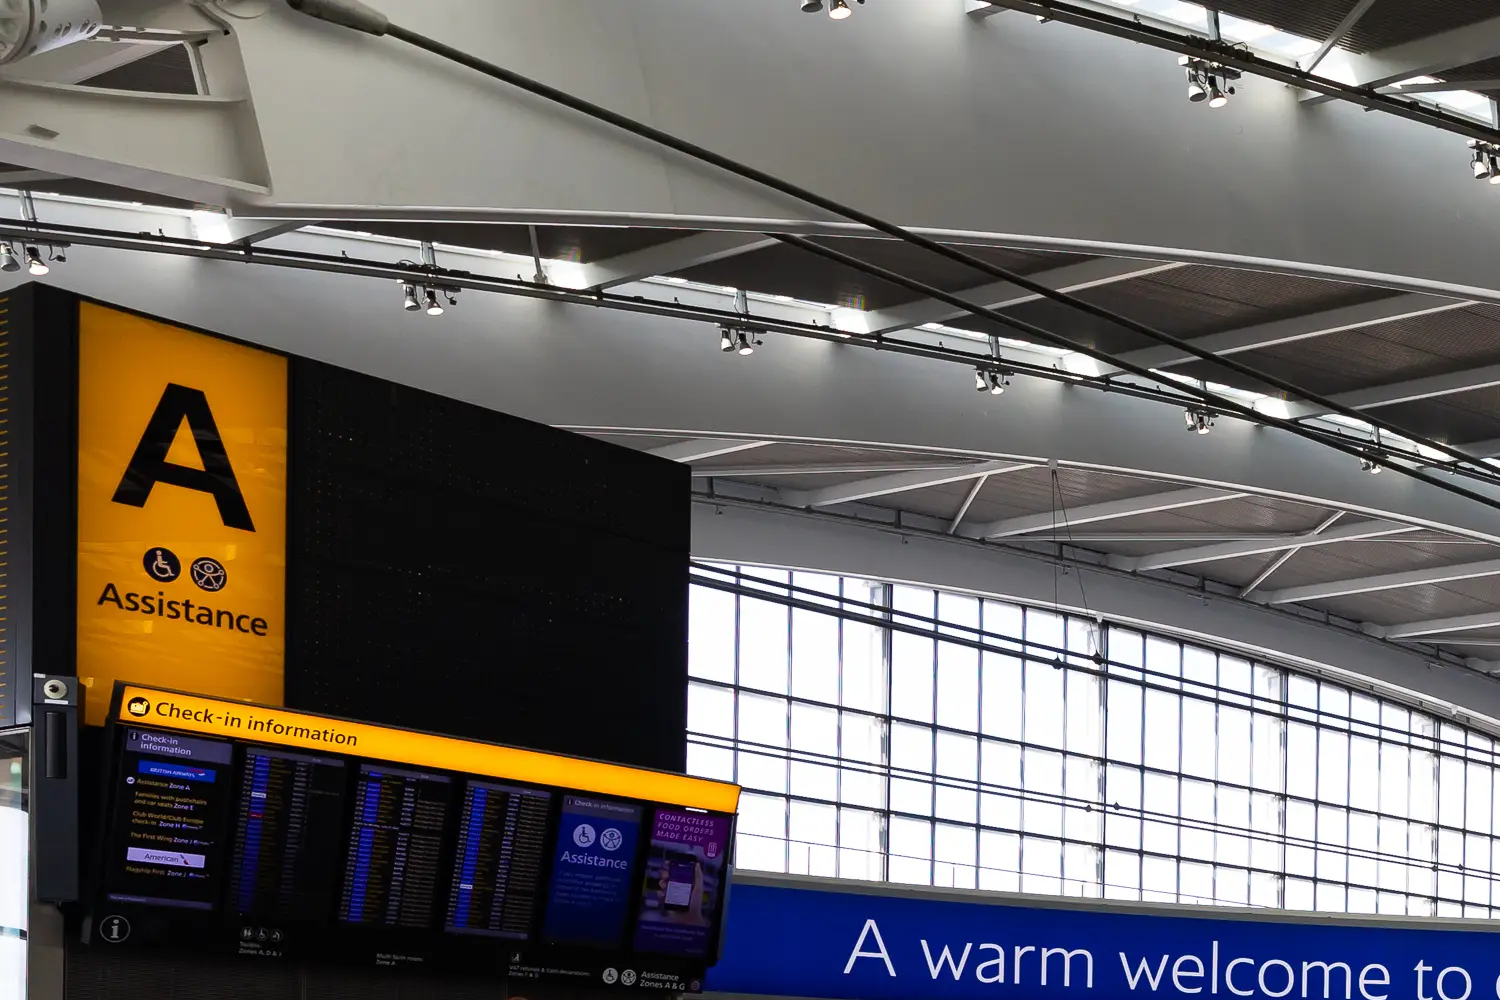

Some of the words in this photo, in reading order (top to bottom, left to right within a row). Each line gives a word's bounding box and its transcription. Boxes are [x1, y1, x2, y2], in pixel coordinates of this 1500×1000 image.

[111, 382, 256, 532] A
[97, 582, 269, 637] Assistance
[155, 702, 241, 728] Check-in
[247, 716, 358, 746] information
[141, 734, 178, 746] Check-in
[140, 742, 192, 756] information
[659, 813, 714, 827] CONTACTLESS
[657, 822, 680, 831] FOOD
[683, 825, 714, 836] ORDERS
[656, 830, 680, 840] MADE
[682, 834, 703, 843] EASY
[144, 852, 178, 863] American
[560, 851, 627, 870] Assistance
[843, 918, 897, 978] A
[920, 938, 1094, 989] warm
[640, 971, 679, 982] Assistance
[640, 979, 663, 989] Zones
[664, 981, 671, 989] A
[672, 981, 678, 990] &
